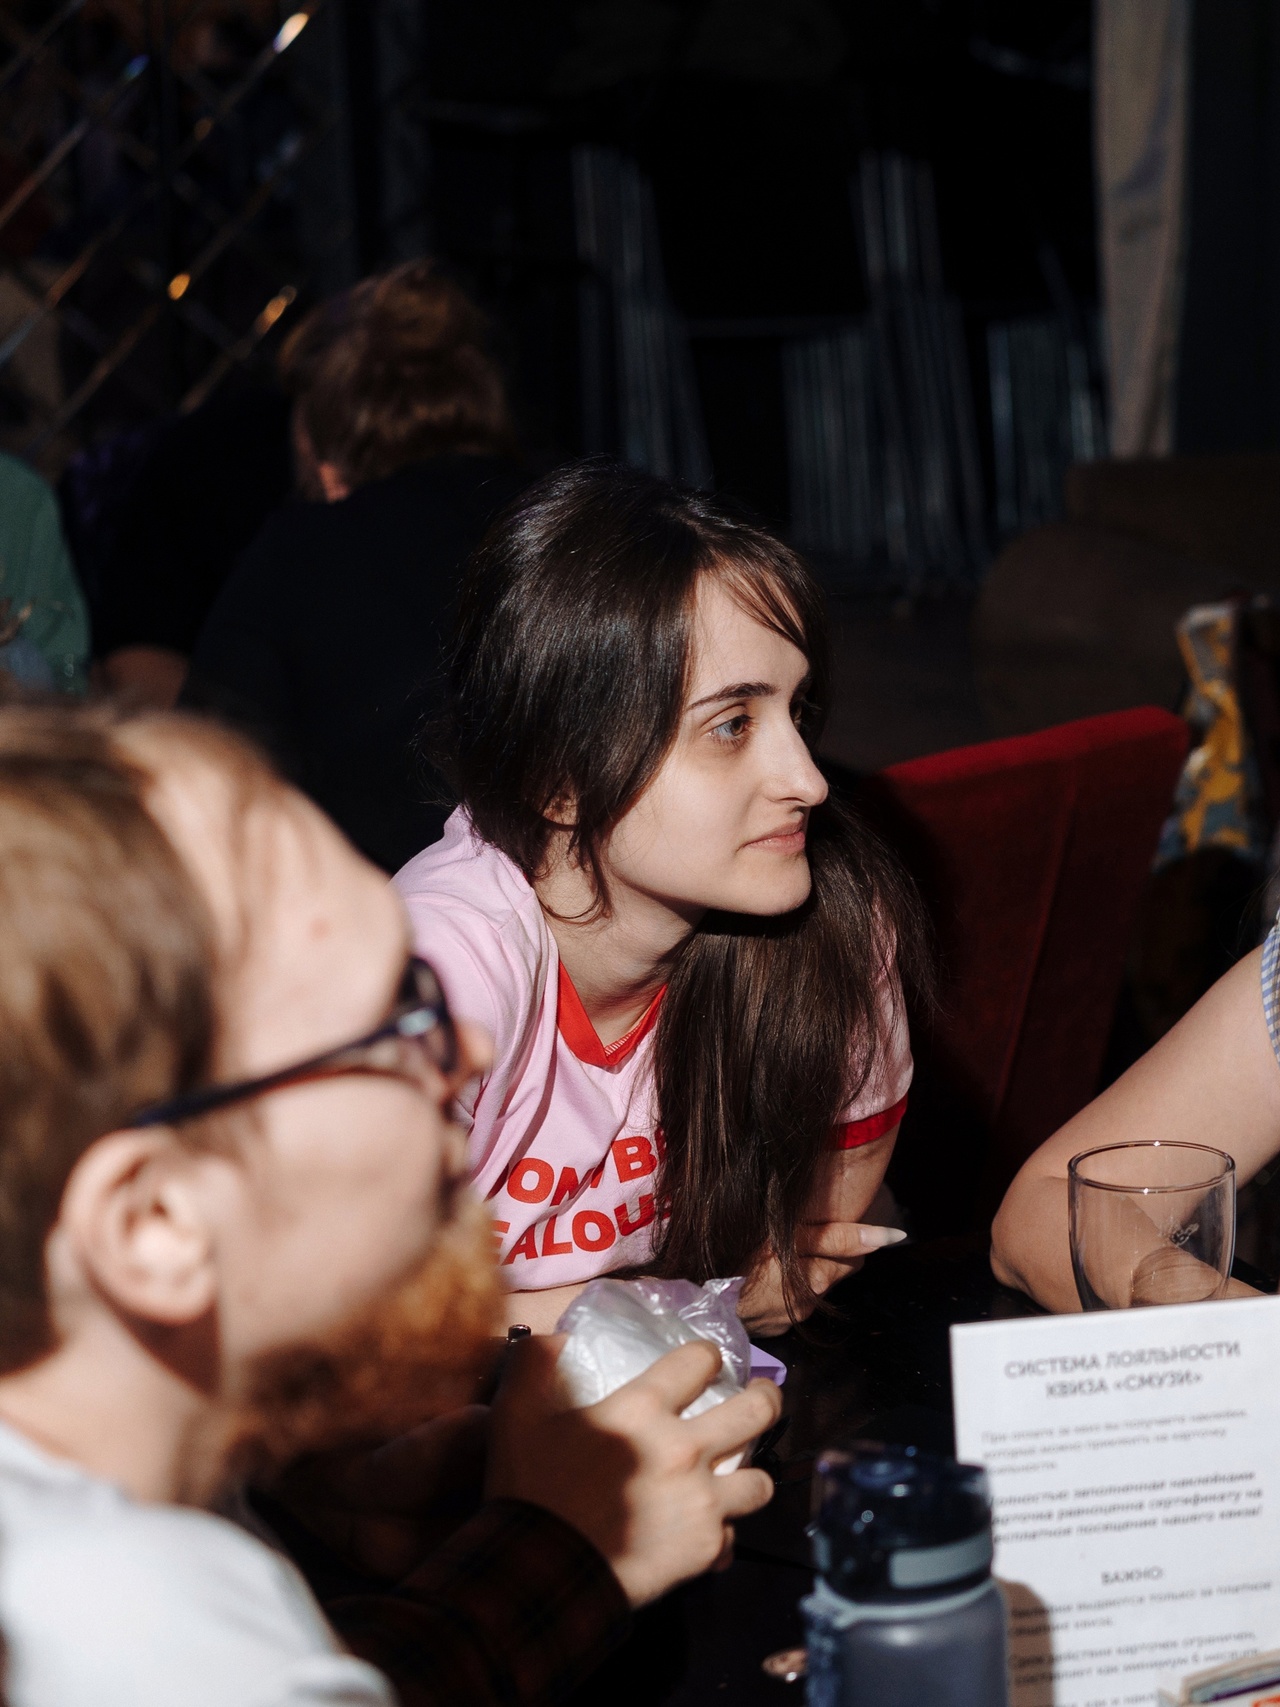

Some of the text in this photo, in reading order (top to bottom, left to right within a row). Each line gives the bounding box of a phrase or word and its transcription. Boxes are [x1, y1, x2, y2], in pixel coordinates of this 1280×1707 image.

[1004, 1338, 1241, 1379] СИСТЕМА ЛОЯЛЬНОСТИ
[1045, 1378, 1109, 1398] КВИЗА
